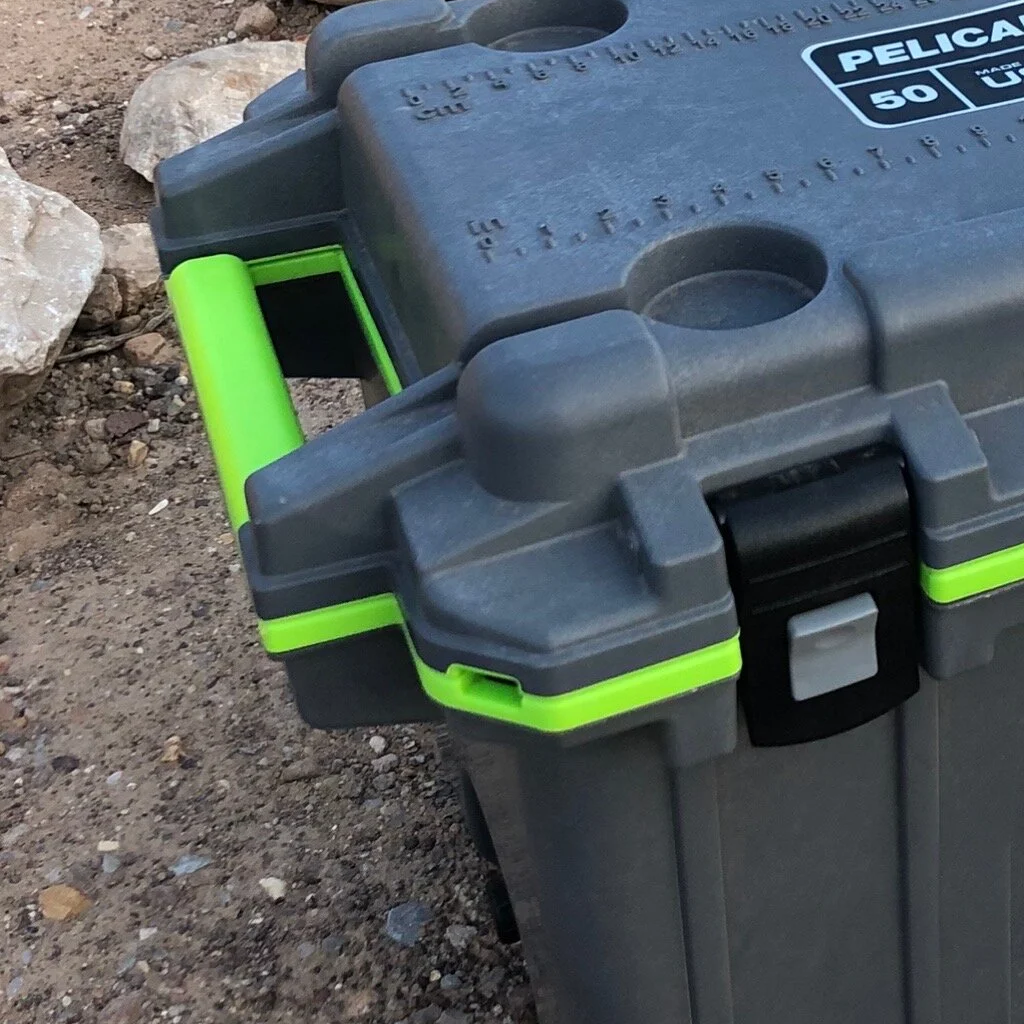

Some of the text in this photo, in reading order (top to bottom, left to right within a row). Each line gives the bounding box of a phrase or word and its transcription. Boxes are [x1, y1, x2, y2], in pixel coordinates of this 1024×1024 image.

[803, 13, 833, 28] 20
[839, 6, 871, 21] 22
[875, 0, 904, 14] 24
[974, 59, 1023, 77] MADE
[868, 83, 939, 110] 50
[866, 145, 884, 160] 7
